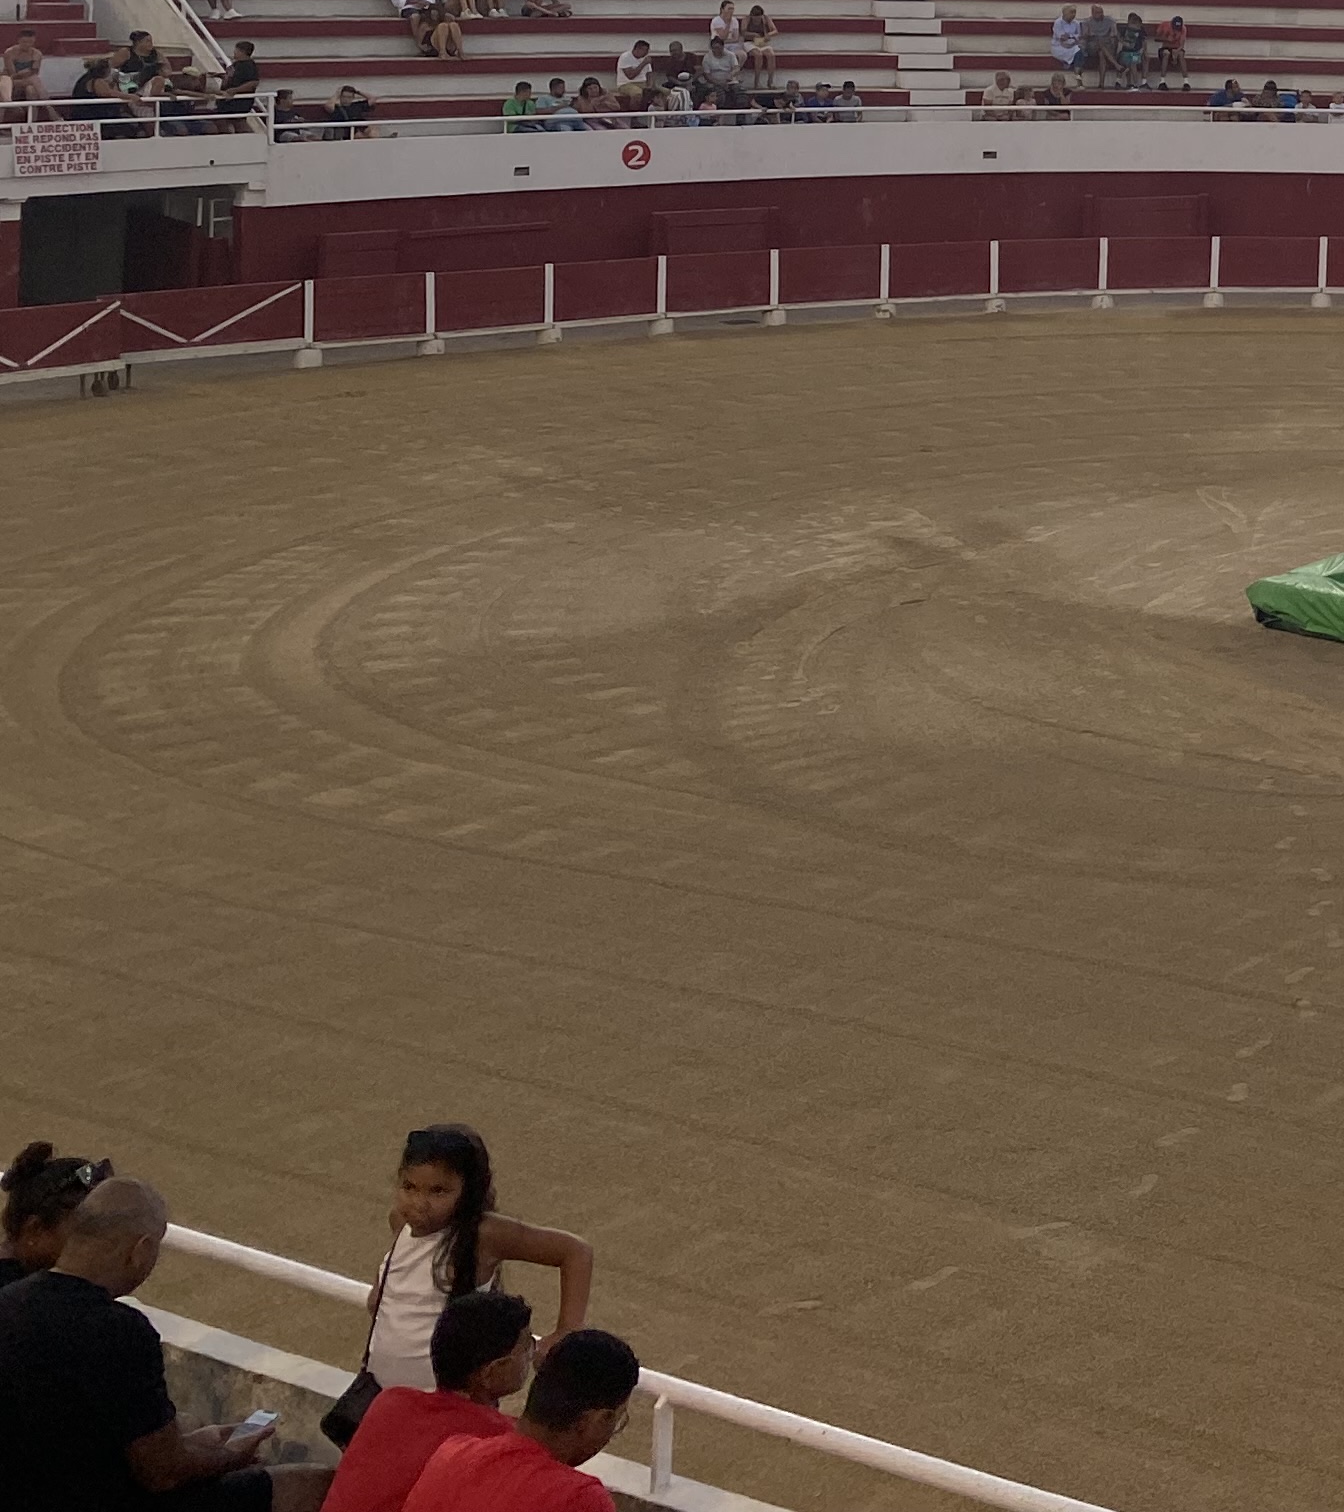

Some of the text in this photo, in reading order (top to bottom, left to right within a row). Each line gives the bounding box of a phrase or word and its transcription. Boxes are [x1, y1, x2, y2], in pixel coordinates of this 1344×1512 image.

[20, 123, 94, 134] LA DIRECTION
[15, 132, 99, 144] NE REPOND PAS
[15, 142, 99, 155] DES ACCIDENTS
[627, 144, 646, 166] 2
[17, 152, 99, 165] EN PISTE ET EN
[20, 161, 97, 175] CONTRE PISTE
